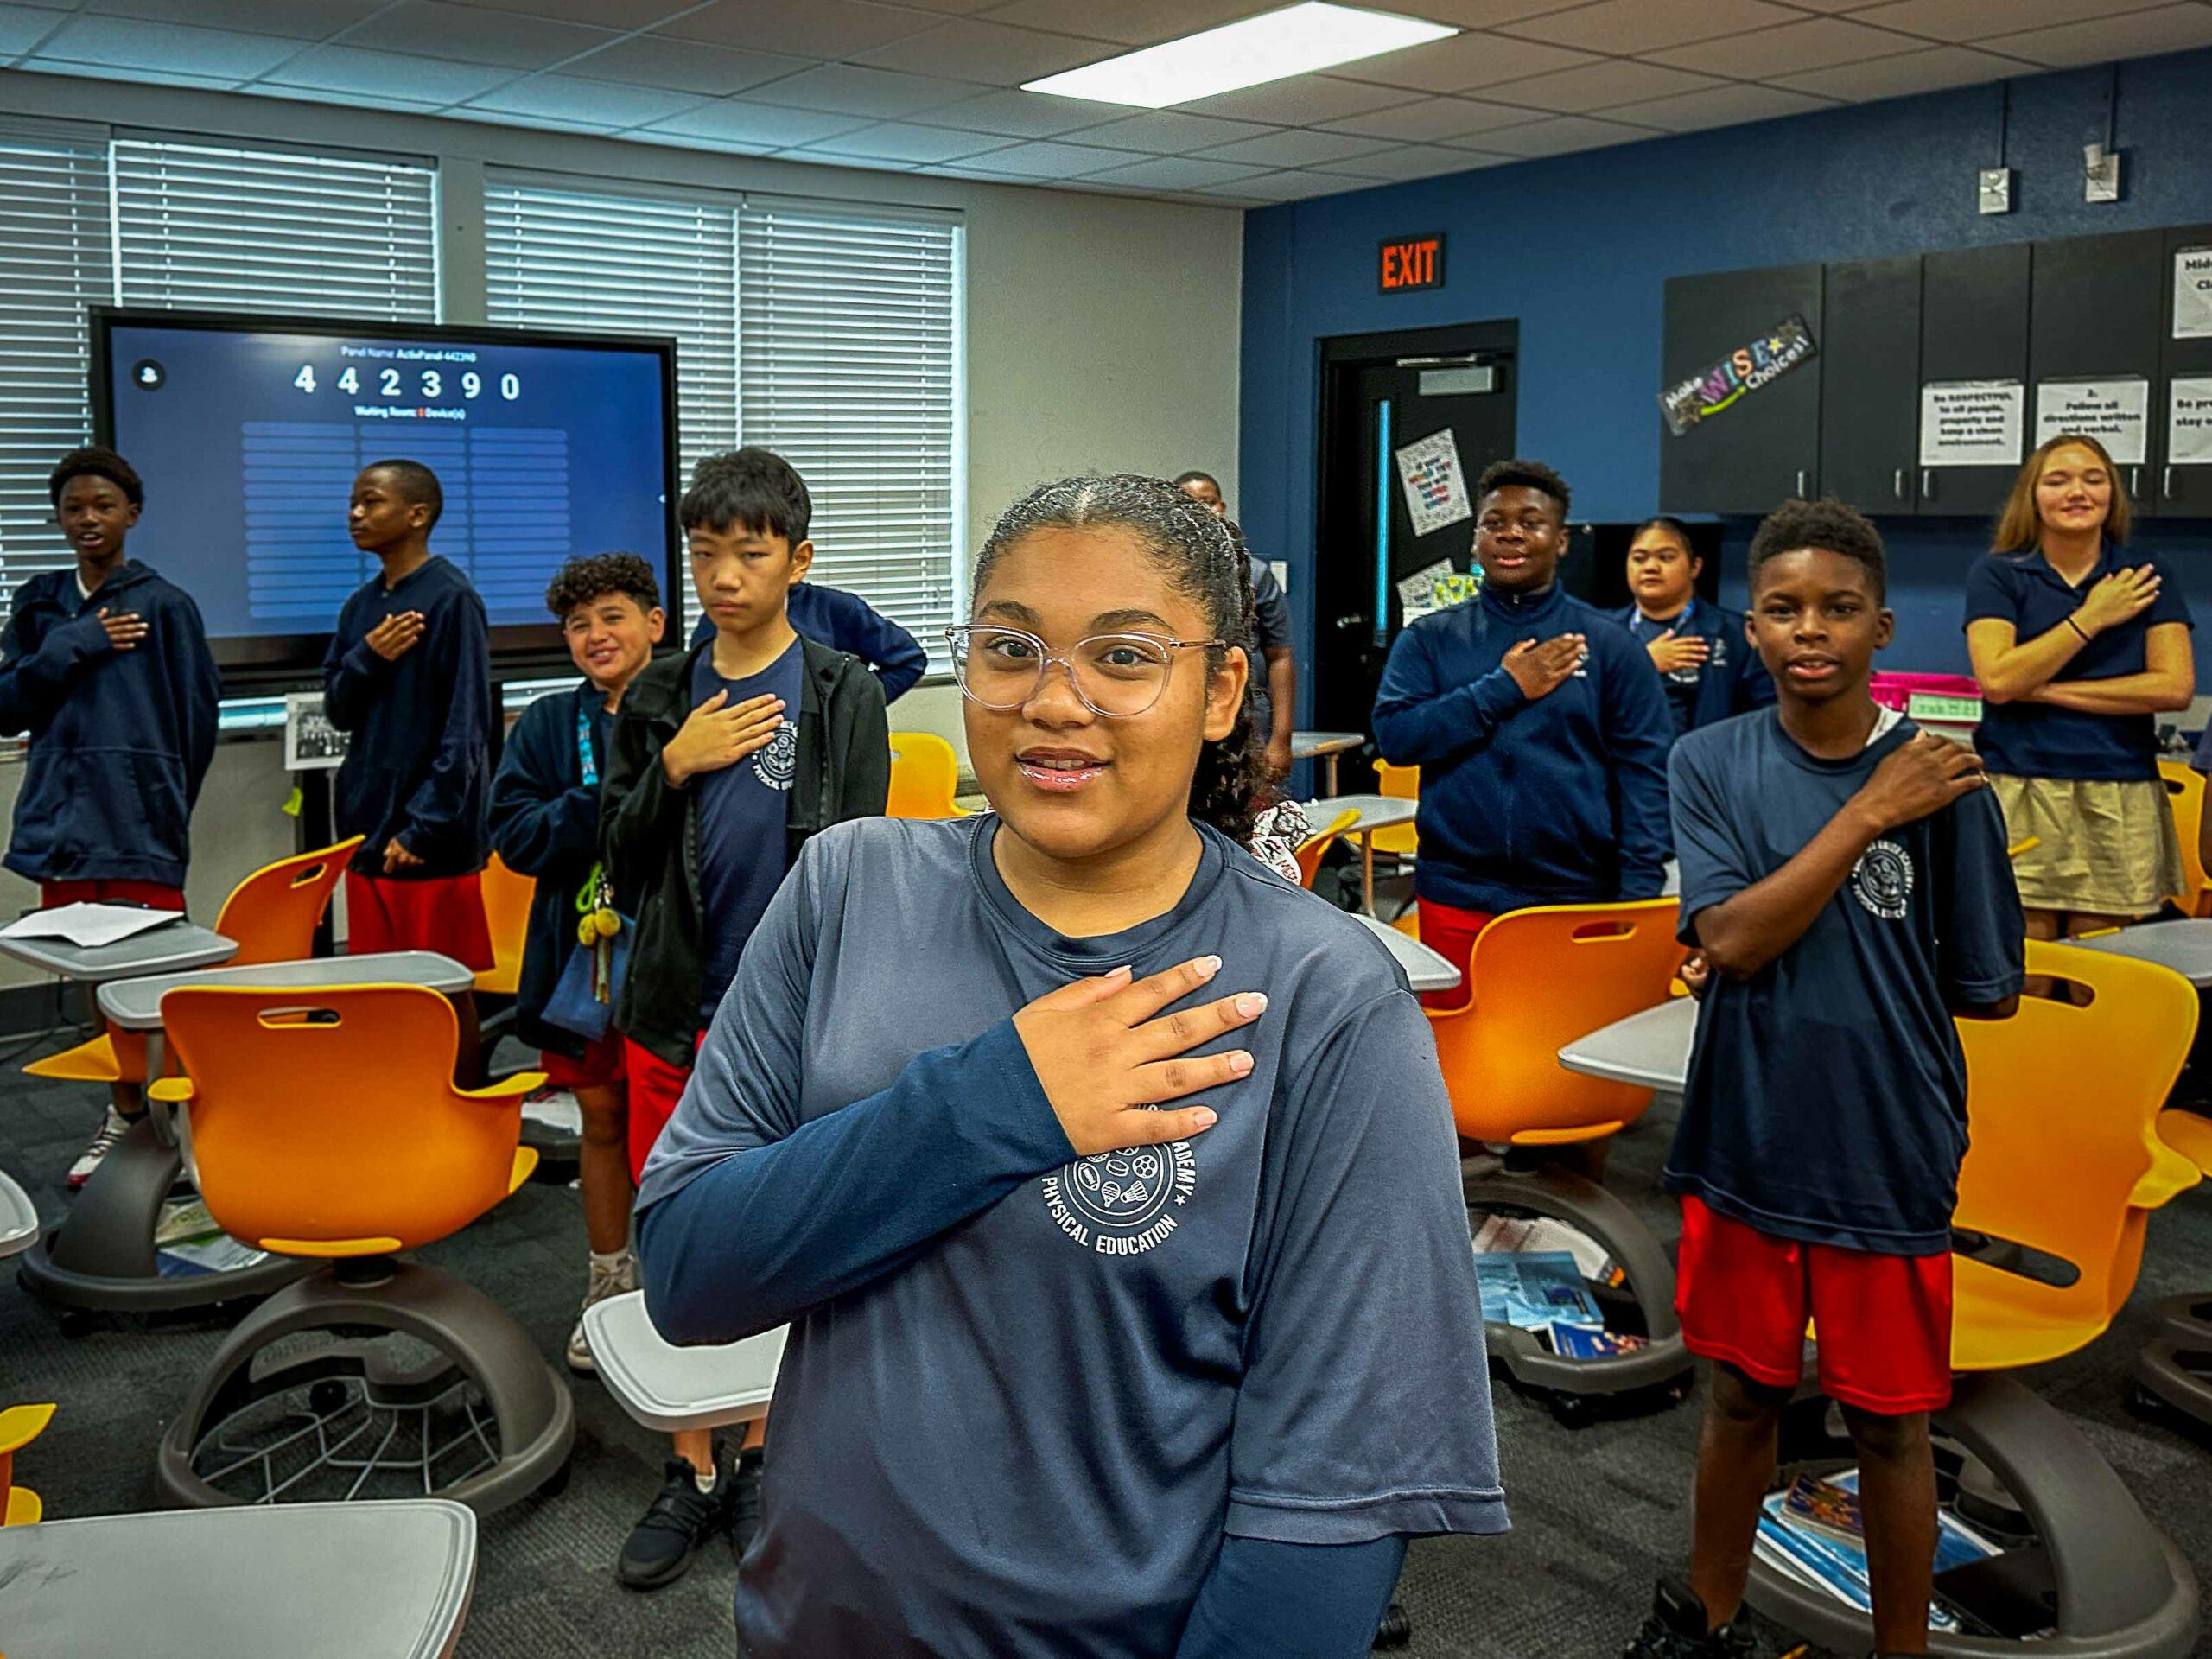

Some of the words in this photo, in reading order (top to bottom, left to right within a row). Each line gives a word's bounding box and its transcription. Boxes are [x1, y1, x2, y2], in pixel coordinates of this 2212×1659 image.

[1382, 240, 1438, 288] EXIT
[2185, 257, 2212, 270] Mid
[1665, 377, 1703, 410] Make
[1699, 340, 1770, 404] WISE
[2177, 399, 2193, 409] Be
[1173, 1141, 1196, 1197] ADEMY
[1041, 1177, 1090, 1246] PHYSICAL
[1096, 1213, 1179, 1255] EDUCATION
